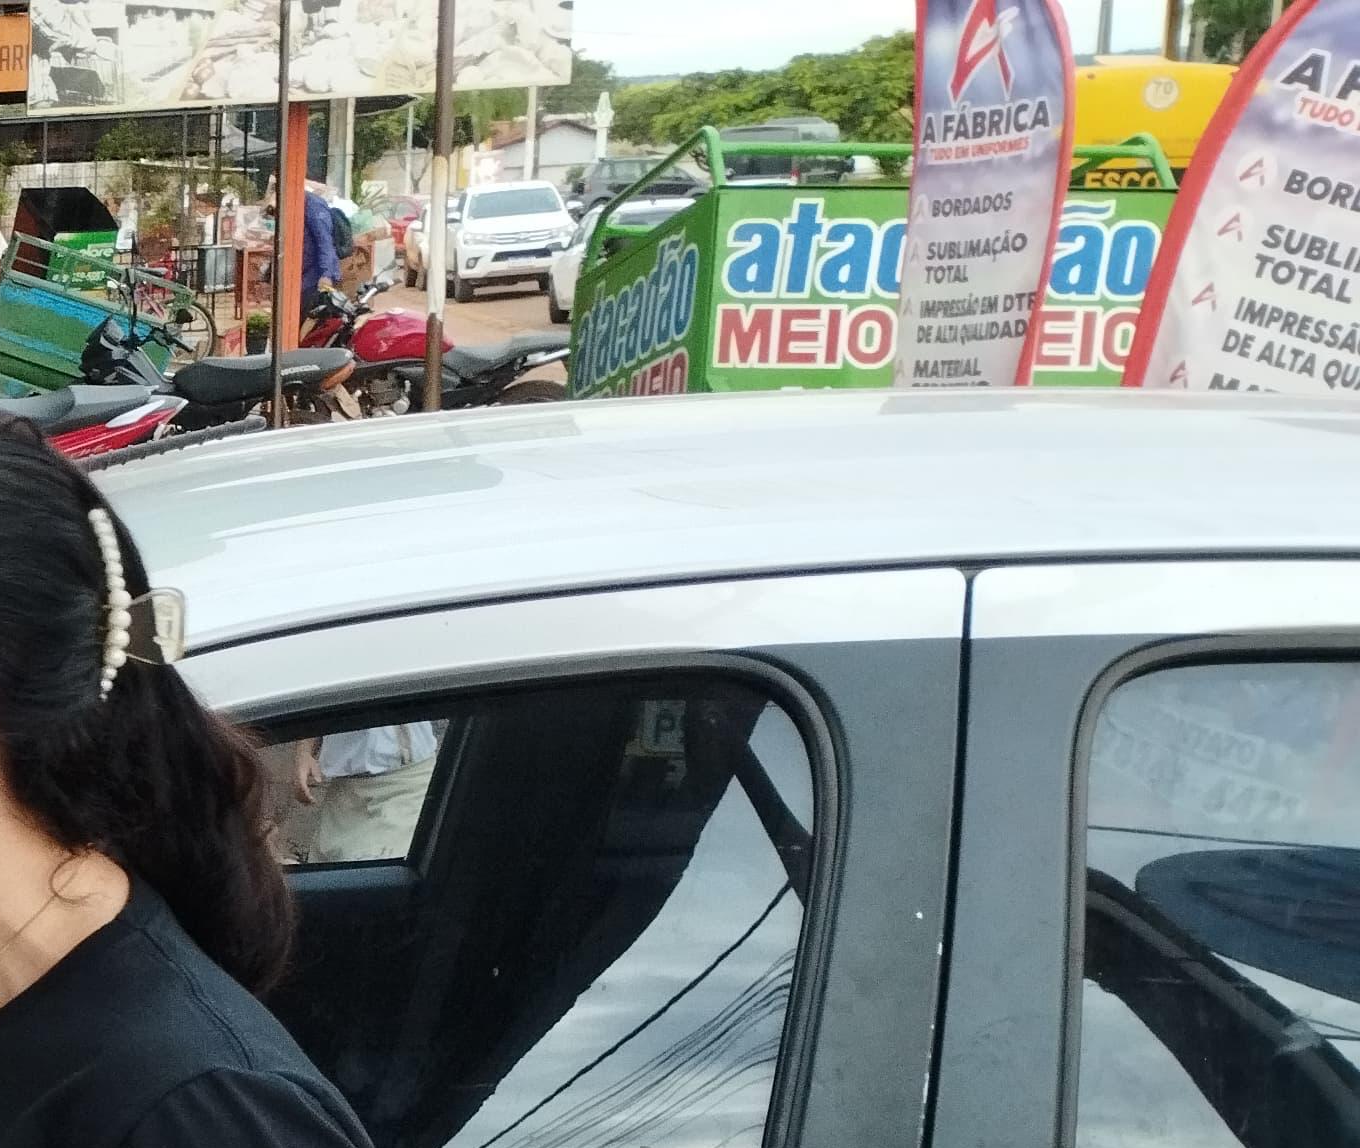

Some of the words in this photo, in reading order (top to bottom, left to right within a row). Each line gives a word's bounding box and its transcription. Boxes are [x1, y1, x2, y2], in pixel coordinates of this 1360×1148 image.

[1280, 52, 1326, 96] A
[922, 115, 936, 144] A
[942, 99, 1050, 143] FÁBRICA
[1298, 96, 1355, 127] TUDO
[931, 191, 1013, 218] BORDADOS
[926, 229, 1028, 263] SUBLIMAÇÃO
[924, 264, 969, 285] TOTAL
[1255, 253, 1353, 304] TOTAL
[919, 293, 980, 319] IMPRESSÃO
[980, 294, 1000, 315] EM
[716, 308, 895, 366] MEIO
[917, 325, 934, 343] DE
[934, 324, 959, 343] ALTA
[912, 357, 982, 378] MATERIAL
[1221, 328, 1256, 358] DE
[1256, 341, 1317, 378] ALTA
